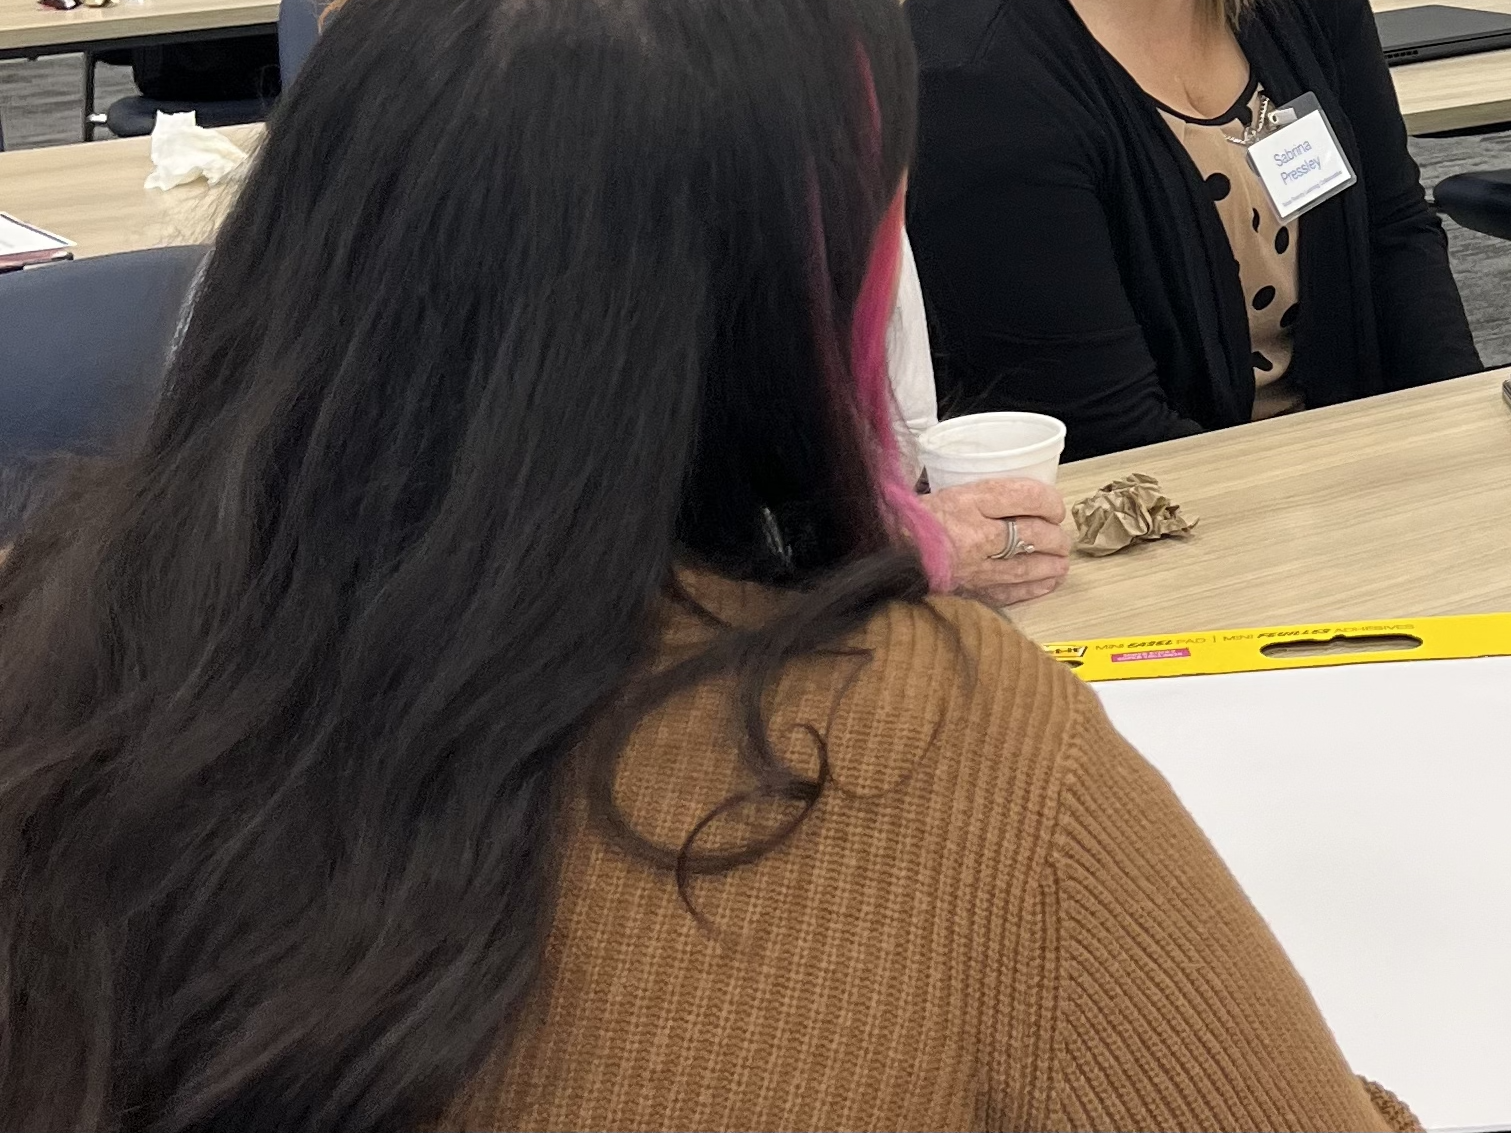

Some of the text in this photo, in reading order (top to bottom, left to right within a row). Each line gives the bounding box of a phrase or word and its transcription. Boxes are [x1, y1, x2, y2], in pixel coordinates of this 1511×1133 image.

[1273, 139, 1312, 166] Sabrina
[1280, 156, 1321, 185] Pressley
[1127, 639, 1173, 649] EASEL
[1176, 637, 1206, 645] PAD
